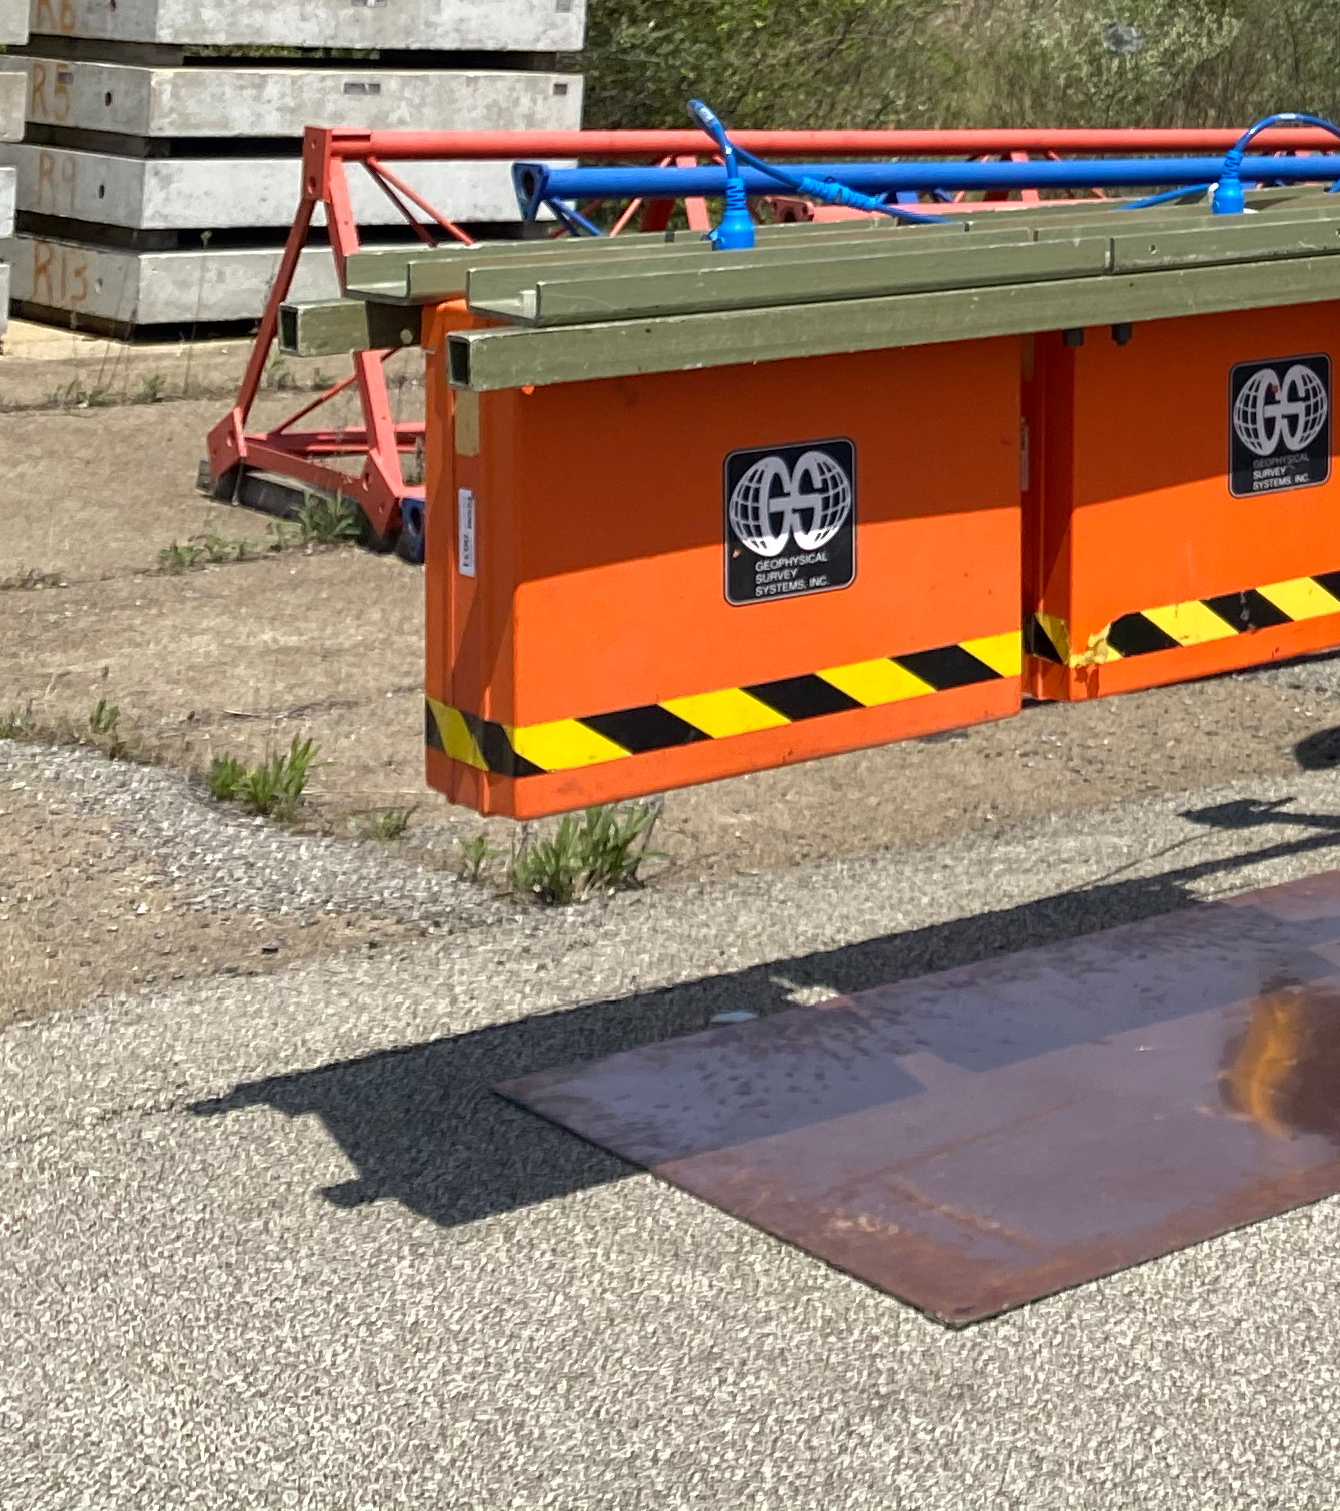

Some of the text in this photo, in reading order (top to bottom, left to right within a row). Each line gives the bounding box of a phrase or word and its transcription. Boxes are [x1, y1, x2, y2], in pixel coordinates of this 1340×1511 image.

[31, 60, 72, 121] R5
[1253, 452, 1311, 469] GEOPHYSICAL
[1253, 466, 1287, 480] SURVEY
[755, 552, 828, 572] GEOPHYSICAL
[755, 568, 798, 585] SURVEY
